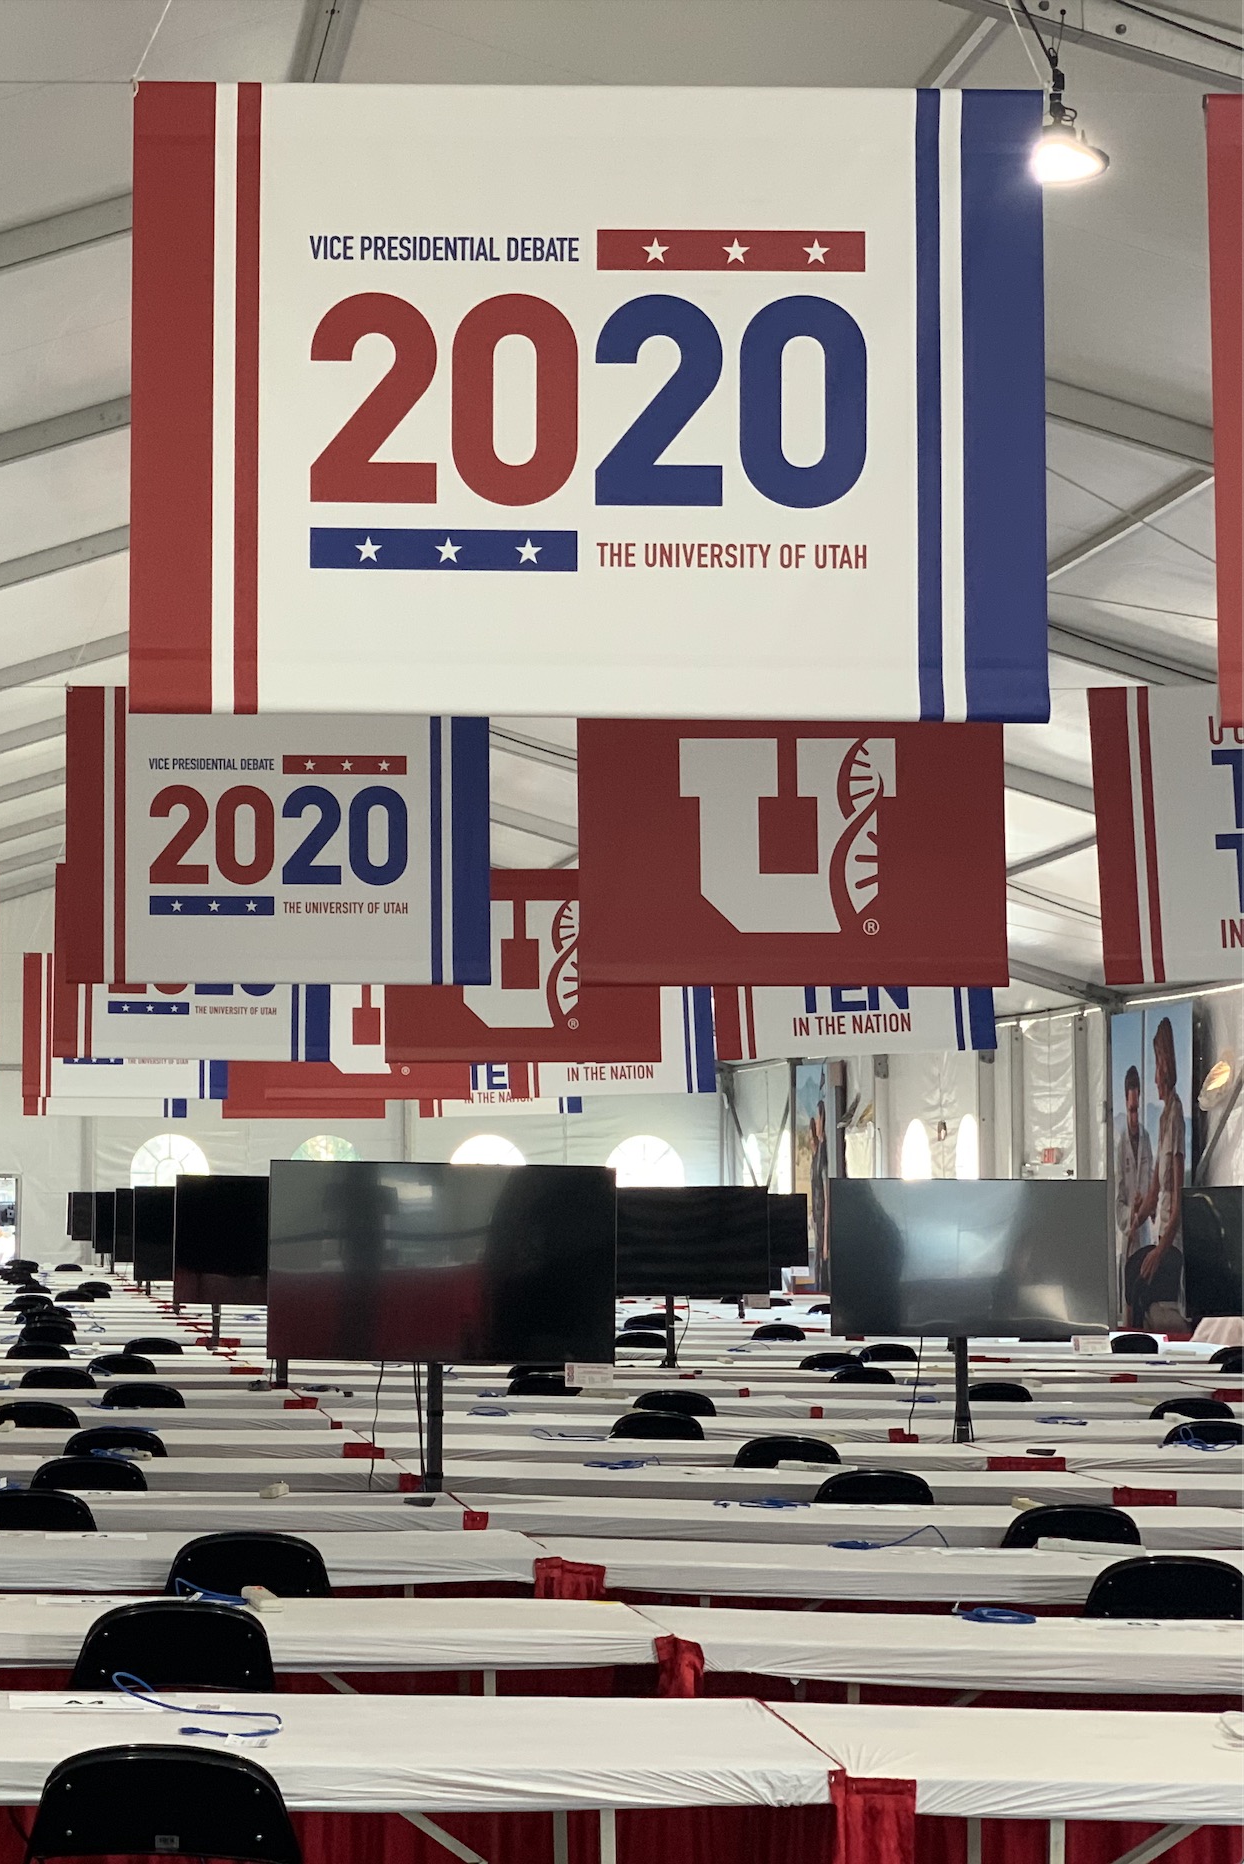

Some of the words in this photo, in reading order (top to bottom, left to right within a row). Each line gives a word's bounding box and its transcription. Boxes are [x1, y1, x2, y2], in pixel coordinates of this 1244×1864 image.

[309, 236, 355, 261] VICE
[360, 236, 501, 262] PRESIDENTIAL
[506, 237, 580, 262] DEBATE
[309, 292, 868, 509] 2020
[596, 542, 637, 568] THE
[644, 542, 772, 569] UNIVERSITY
[779, 543, 807, 569] OF
[814, 544, 868, 570] UTAH
[148, 757, 170, 770] VICE
[172, 757, 238, 771] PRESIDENTIAL
[240, 758, 275, 771] DEBATE
[149, 784, 409, 887] 2020
[282, 901, 302, 914] THE
[305, 901, 364, 914] UNIVERSITY
[367, 901, 380, 914] OF
[383, 901, 409, 915] UTAH
[195, 1005, 208, 1015] THE
[209, 1006, 248, 1015] UNIVERSITY
[250, 1006, 259, 1015] OF
[260, 1006, 277, 1016] UTAH
[793, 1017, 810, 1037] IN
[815, 1015, 847, 1036] THE
[852, 1012, 912, 1034] NATION
[567, 1066, 580, 1082] IN
[583, 1065, 606, 1081] THE
[610, 1063, 654, 1081] NATION
[477, 1092, 496, 1104] THE
